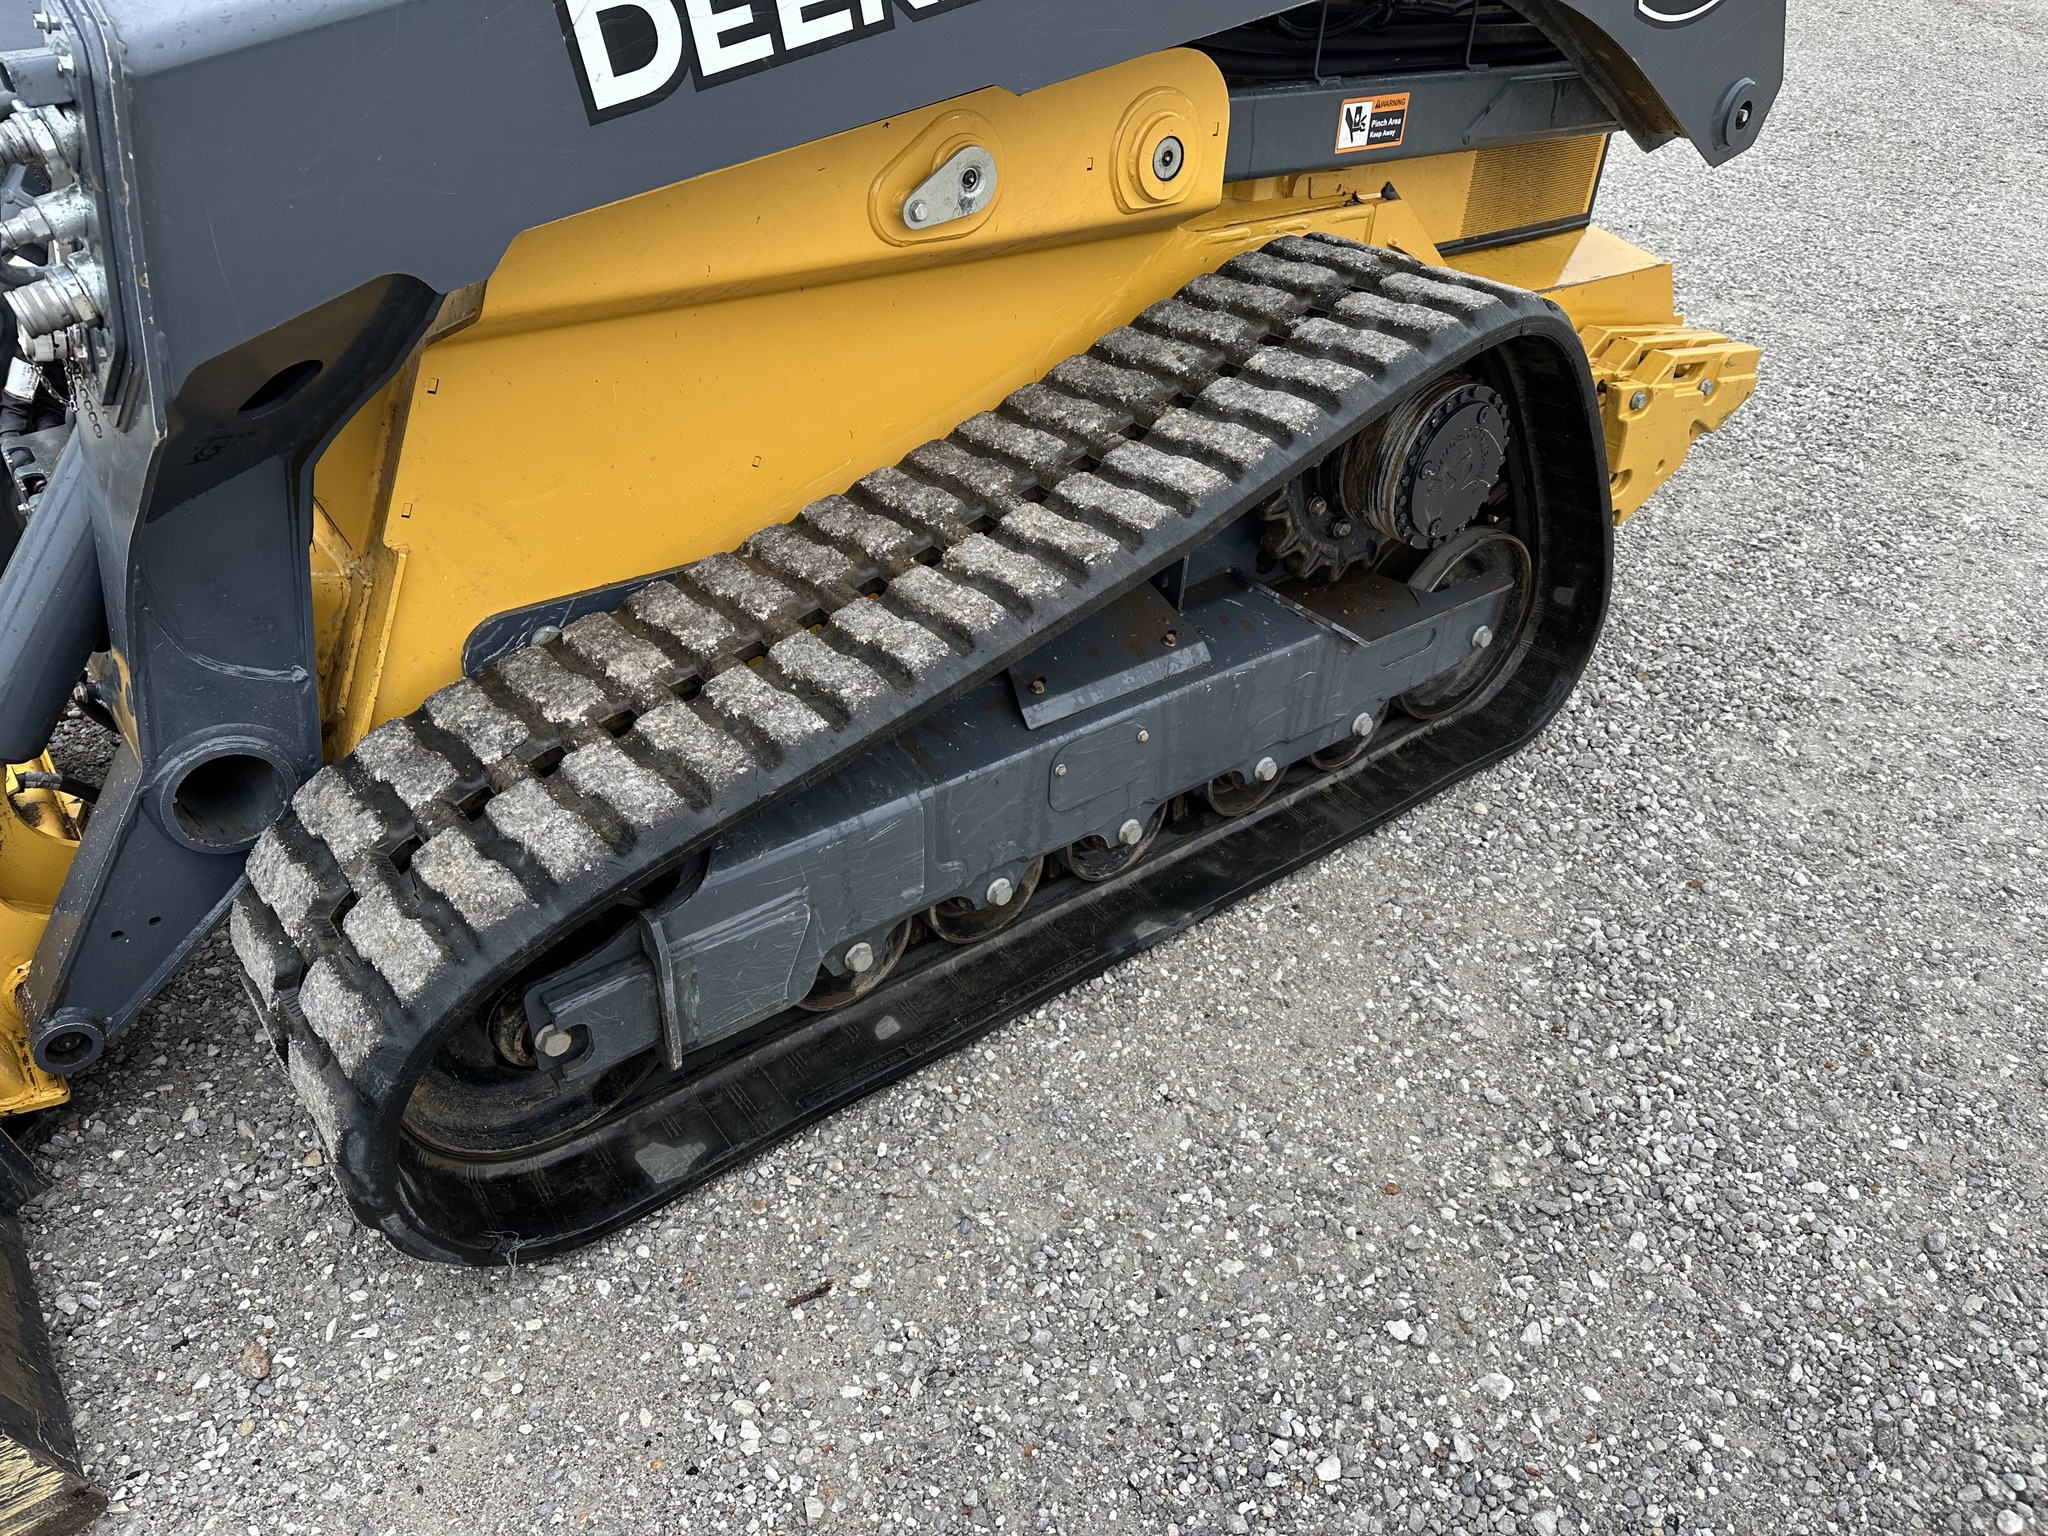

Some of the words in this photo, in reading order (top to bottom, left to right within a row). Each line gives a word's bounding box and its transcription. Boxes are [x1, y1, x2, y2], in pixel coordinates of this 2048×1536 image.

[1380, 98, 1406, 107] WARNING
[1371, 119, 1387, 128] Pinch
[1388, 117, 1401, 126] Area
[1369, 131, 1382, 139] Keep
[1383, 129, 1396, 137] Away
